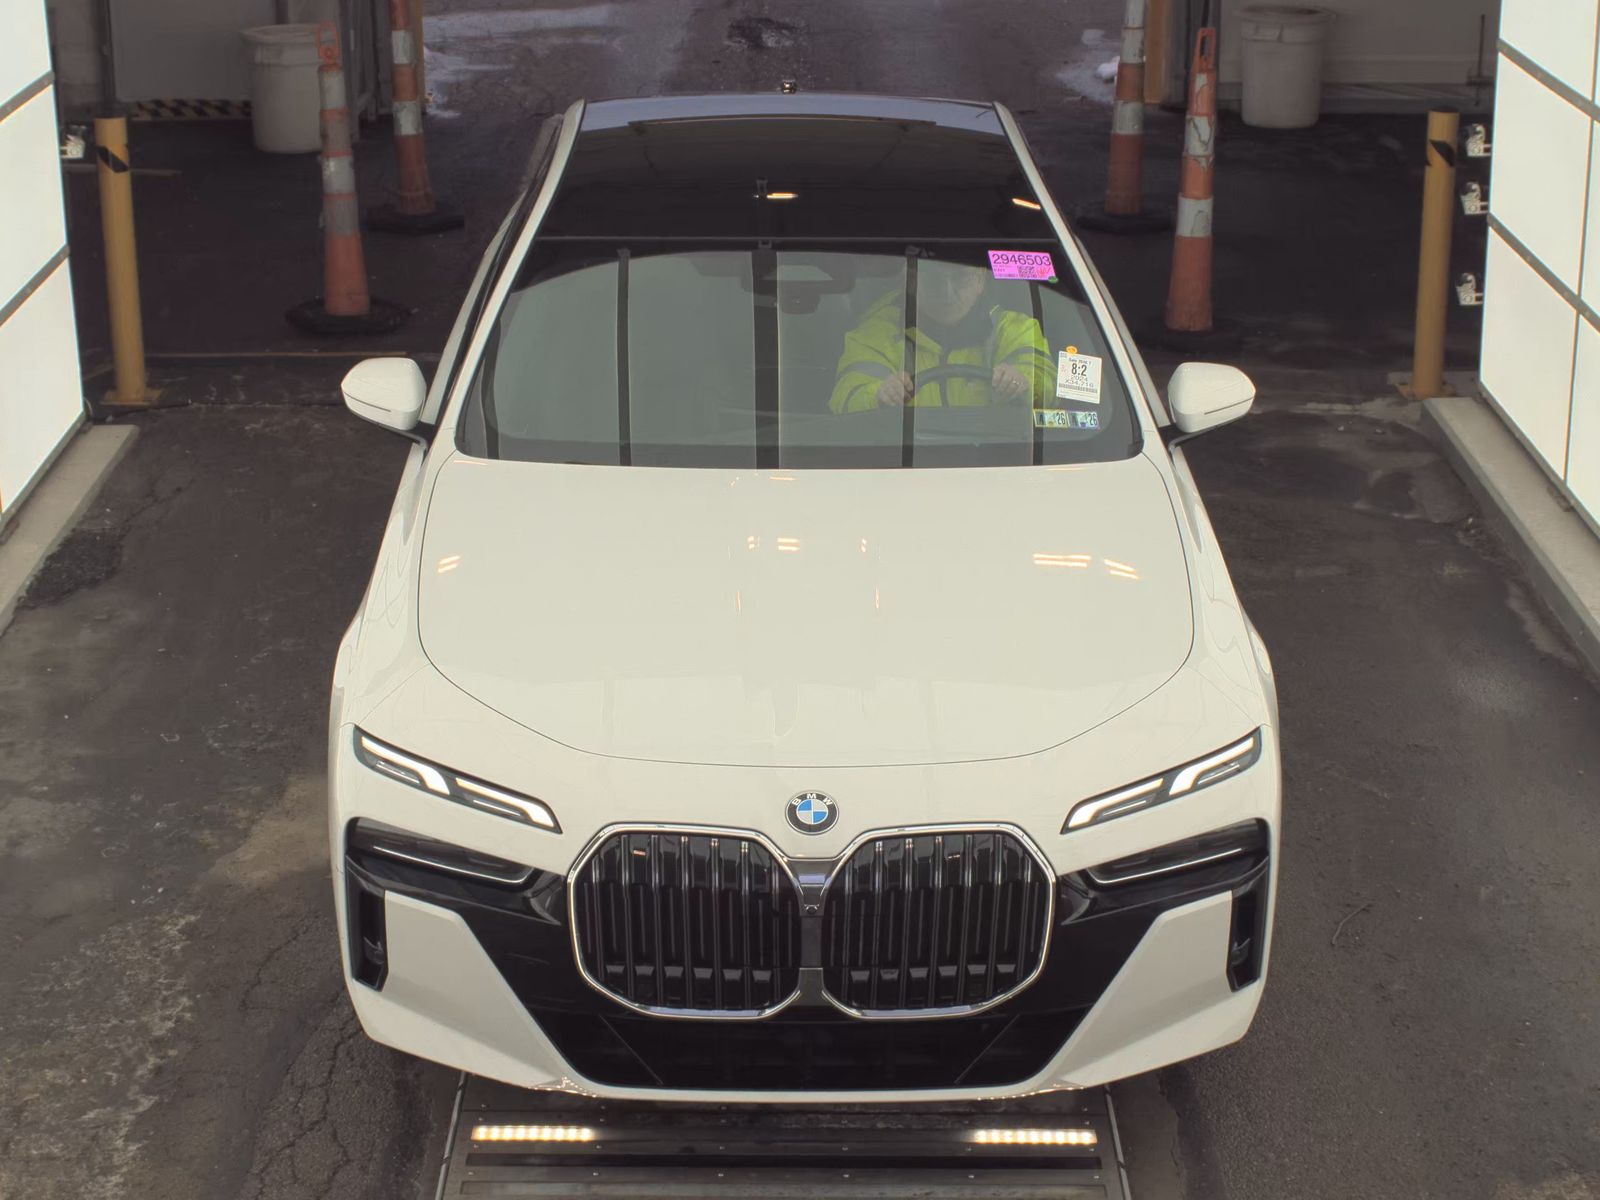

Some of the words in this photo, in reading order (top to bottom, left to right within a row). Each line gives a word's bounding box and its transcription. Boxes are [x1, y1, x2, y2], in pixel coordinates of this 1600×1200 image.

[992, 253, 1051, 266] 2946503
[1071, 362, 1087, 377] 8:2
[791, 793, 833, 806] BMW
